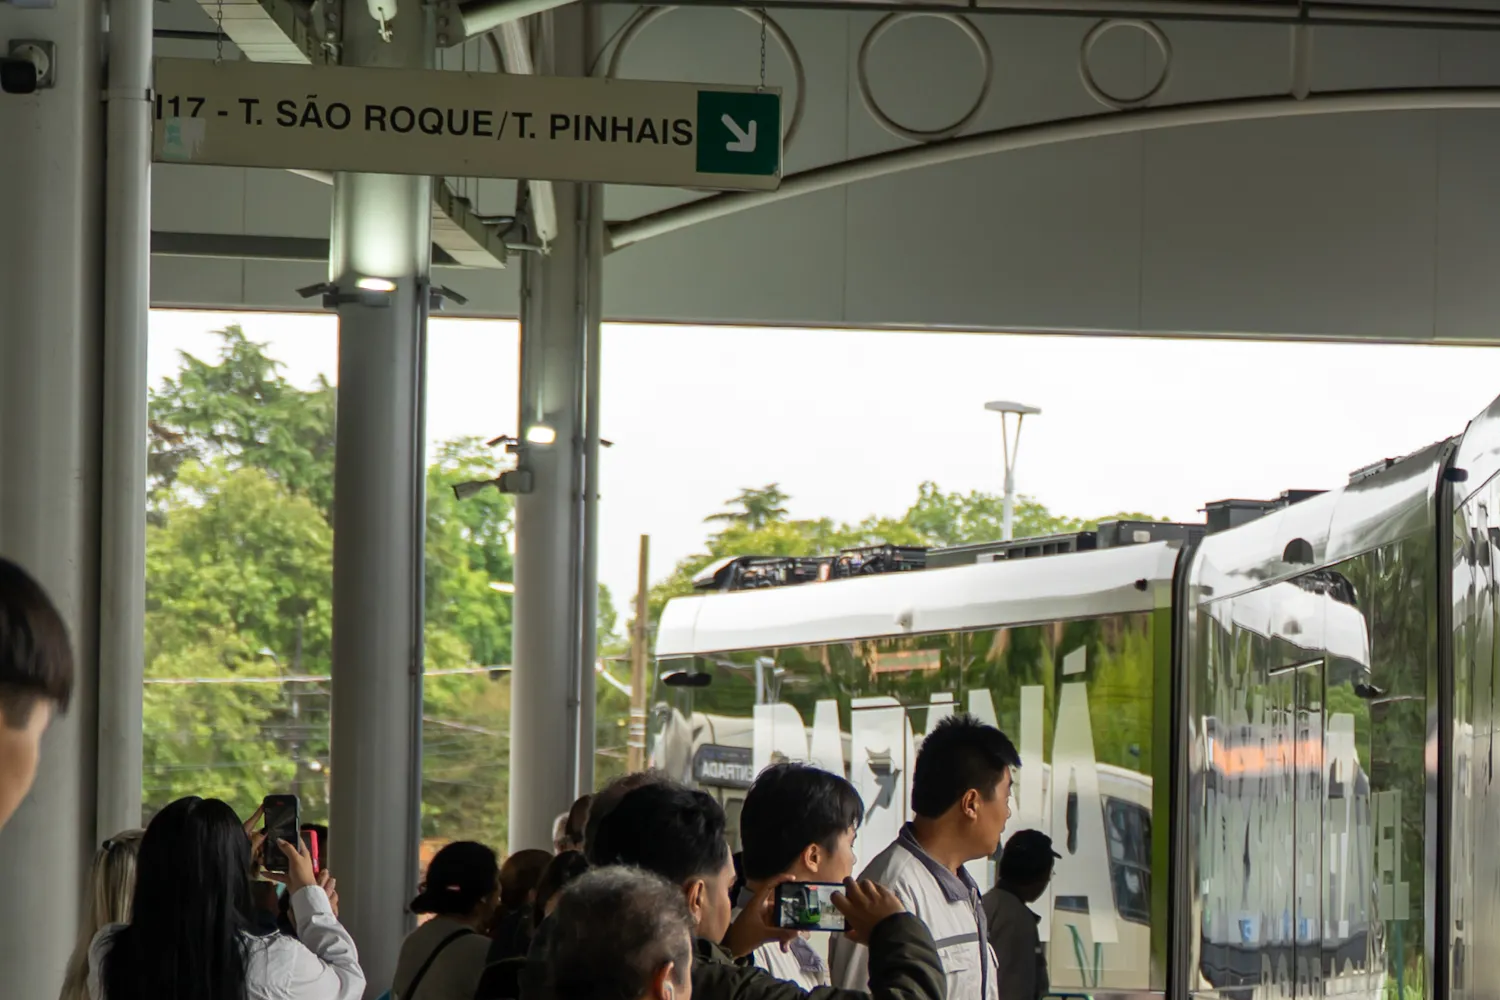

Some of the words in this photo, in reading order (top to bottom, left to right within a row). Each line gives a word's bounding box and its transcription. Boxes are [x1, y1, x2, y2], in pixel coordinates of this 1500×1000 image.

[238, 98, 262, 126] T.
[276, 94, 351, 130] SÃO
[550, 113, 693, 146] PINHAIS
